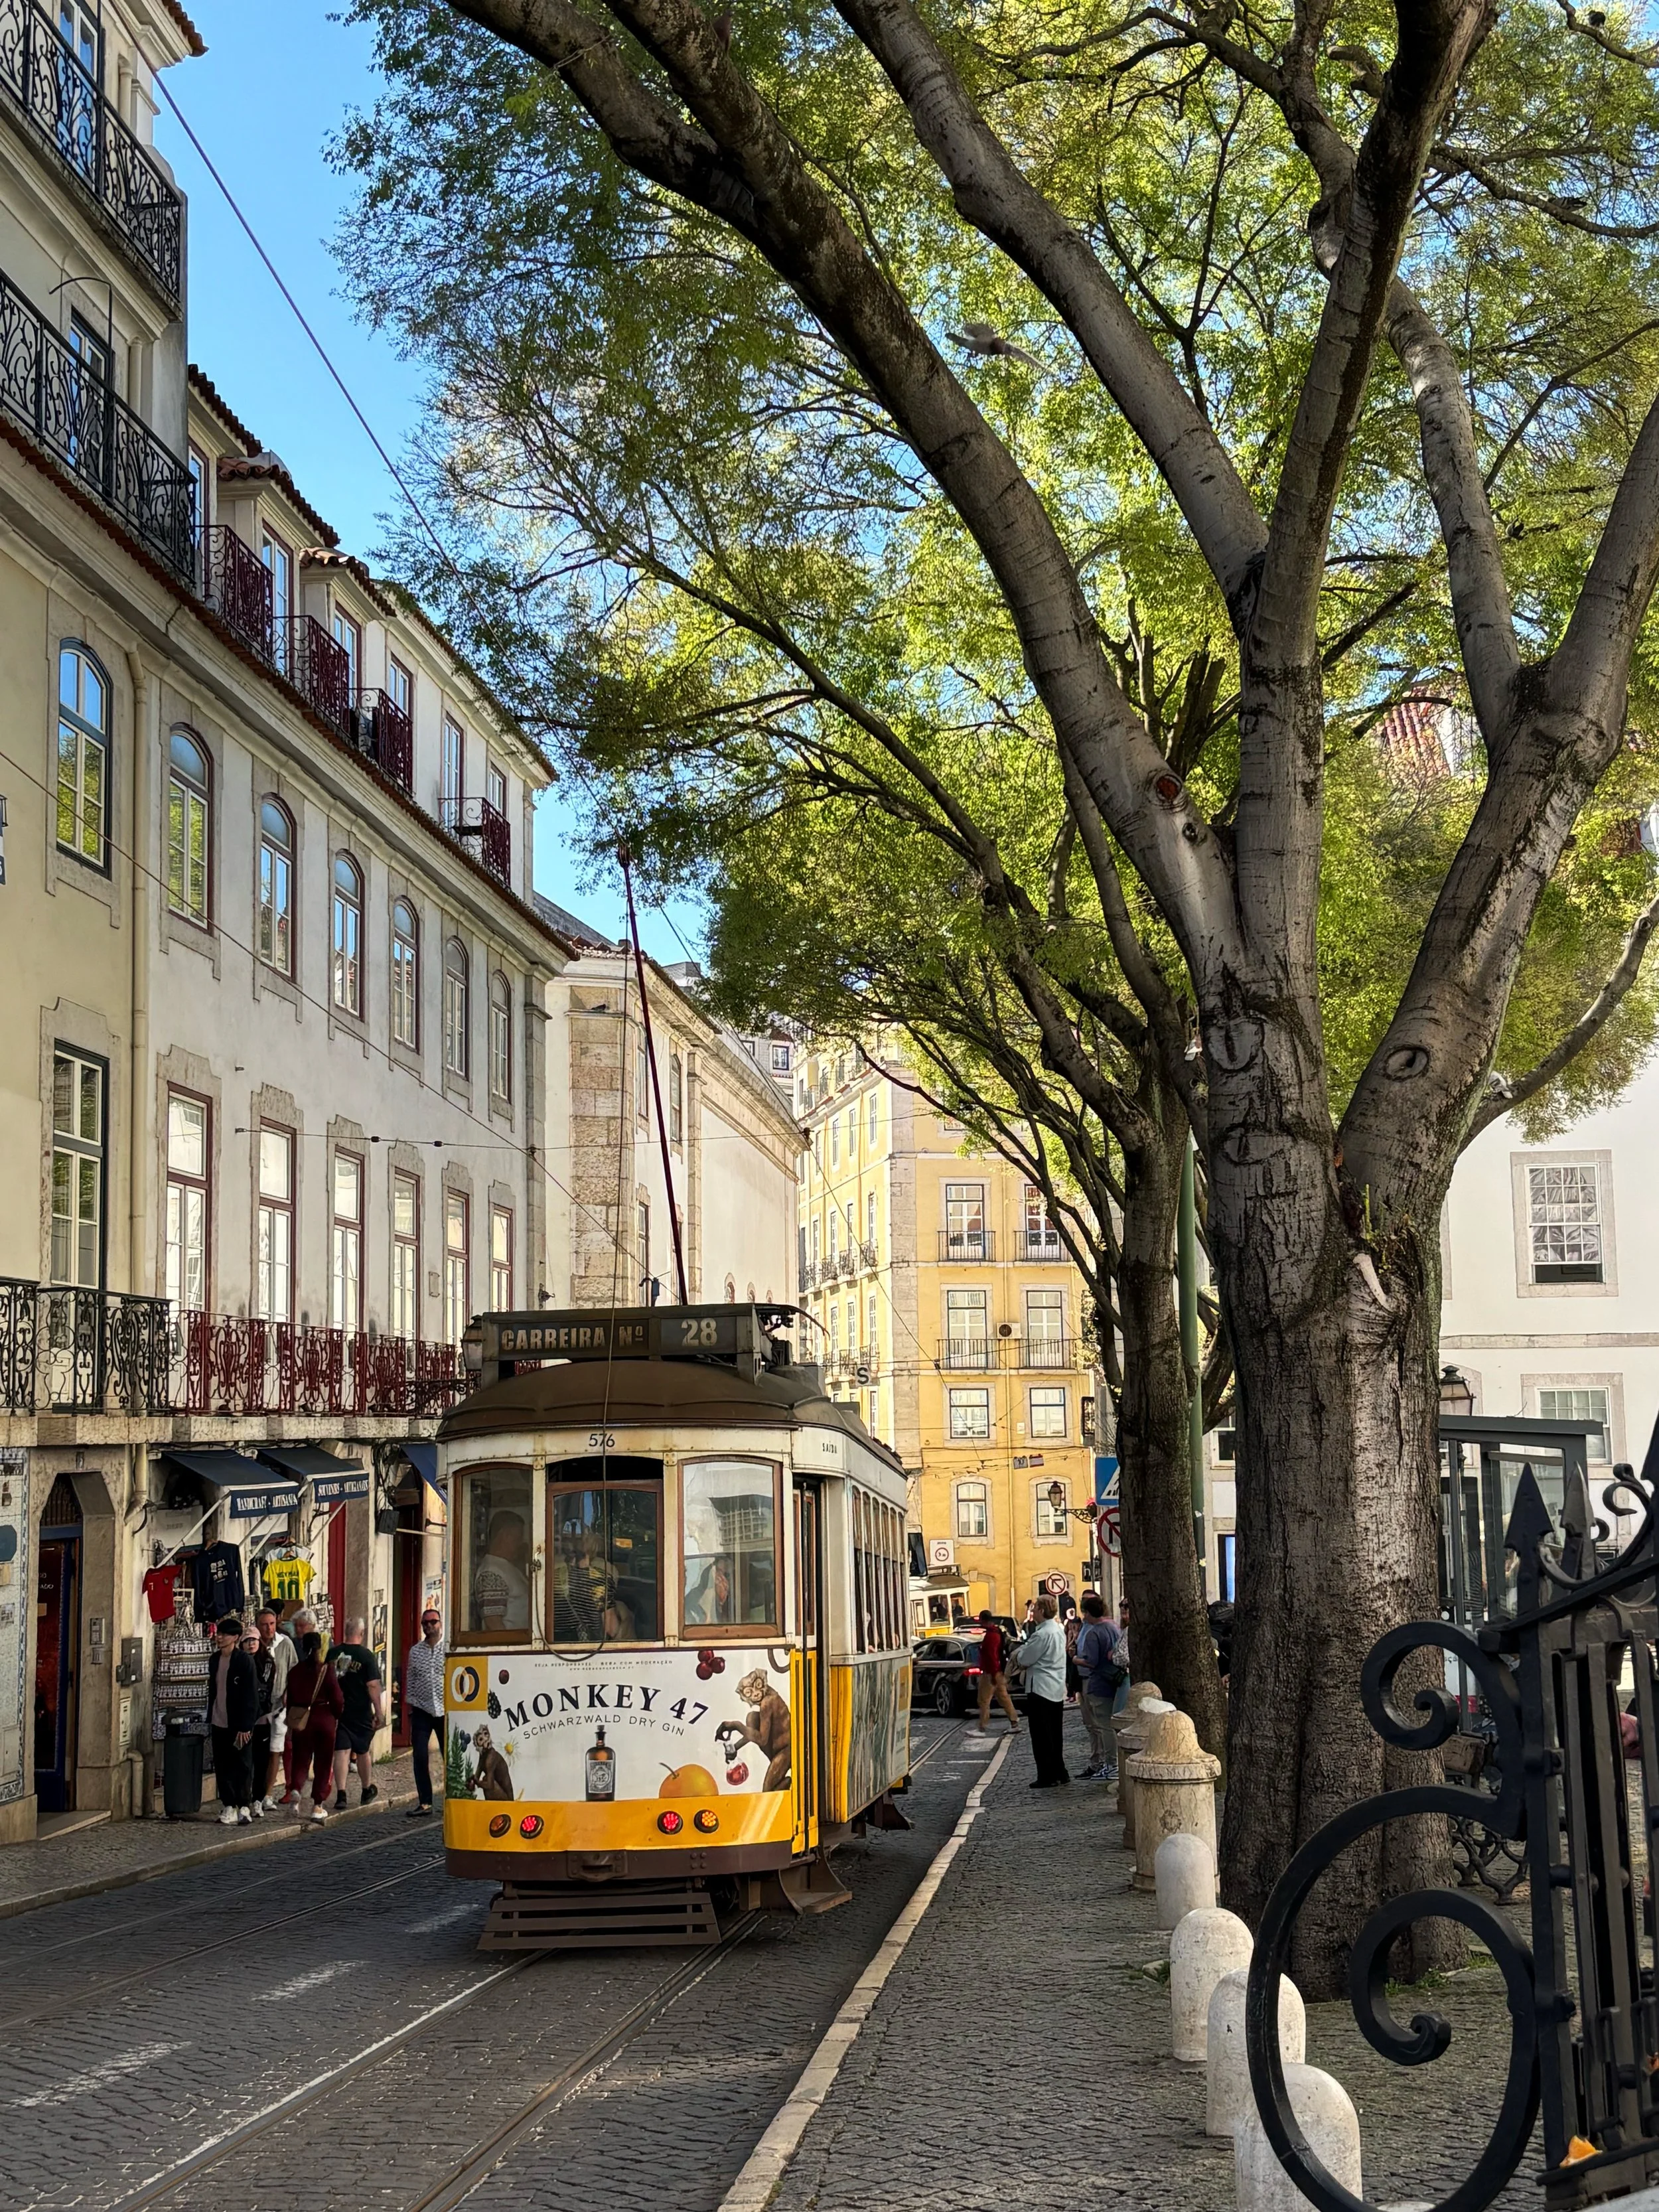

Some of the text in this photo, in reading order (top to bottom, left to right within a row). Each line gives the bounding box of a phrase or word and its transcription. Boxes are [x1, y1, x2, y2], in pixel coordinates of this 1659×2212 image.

[501, 1327, 606, 1351] CARREIRA
[681, 1317, 718, 1347] 28
[857, 1366, 869, 1385] S
[589, 1433, 615, 1447] 576
[503, 1684, 709, 1732] MONKEY 47
[523, 1714, 685, 1739] SCHWARZWALD DRY GIN
